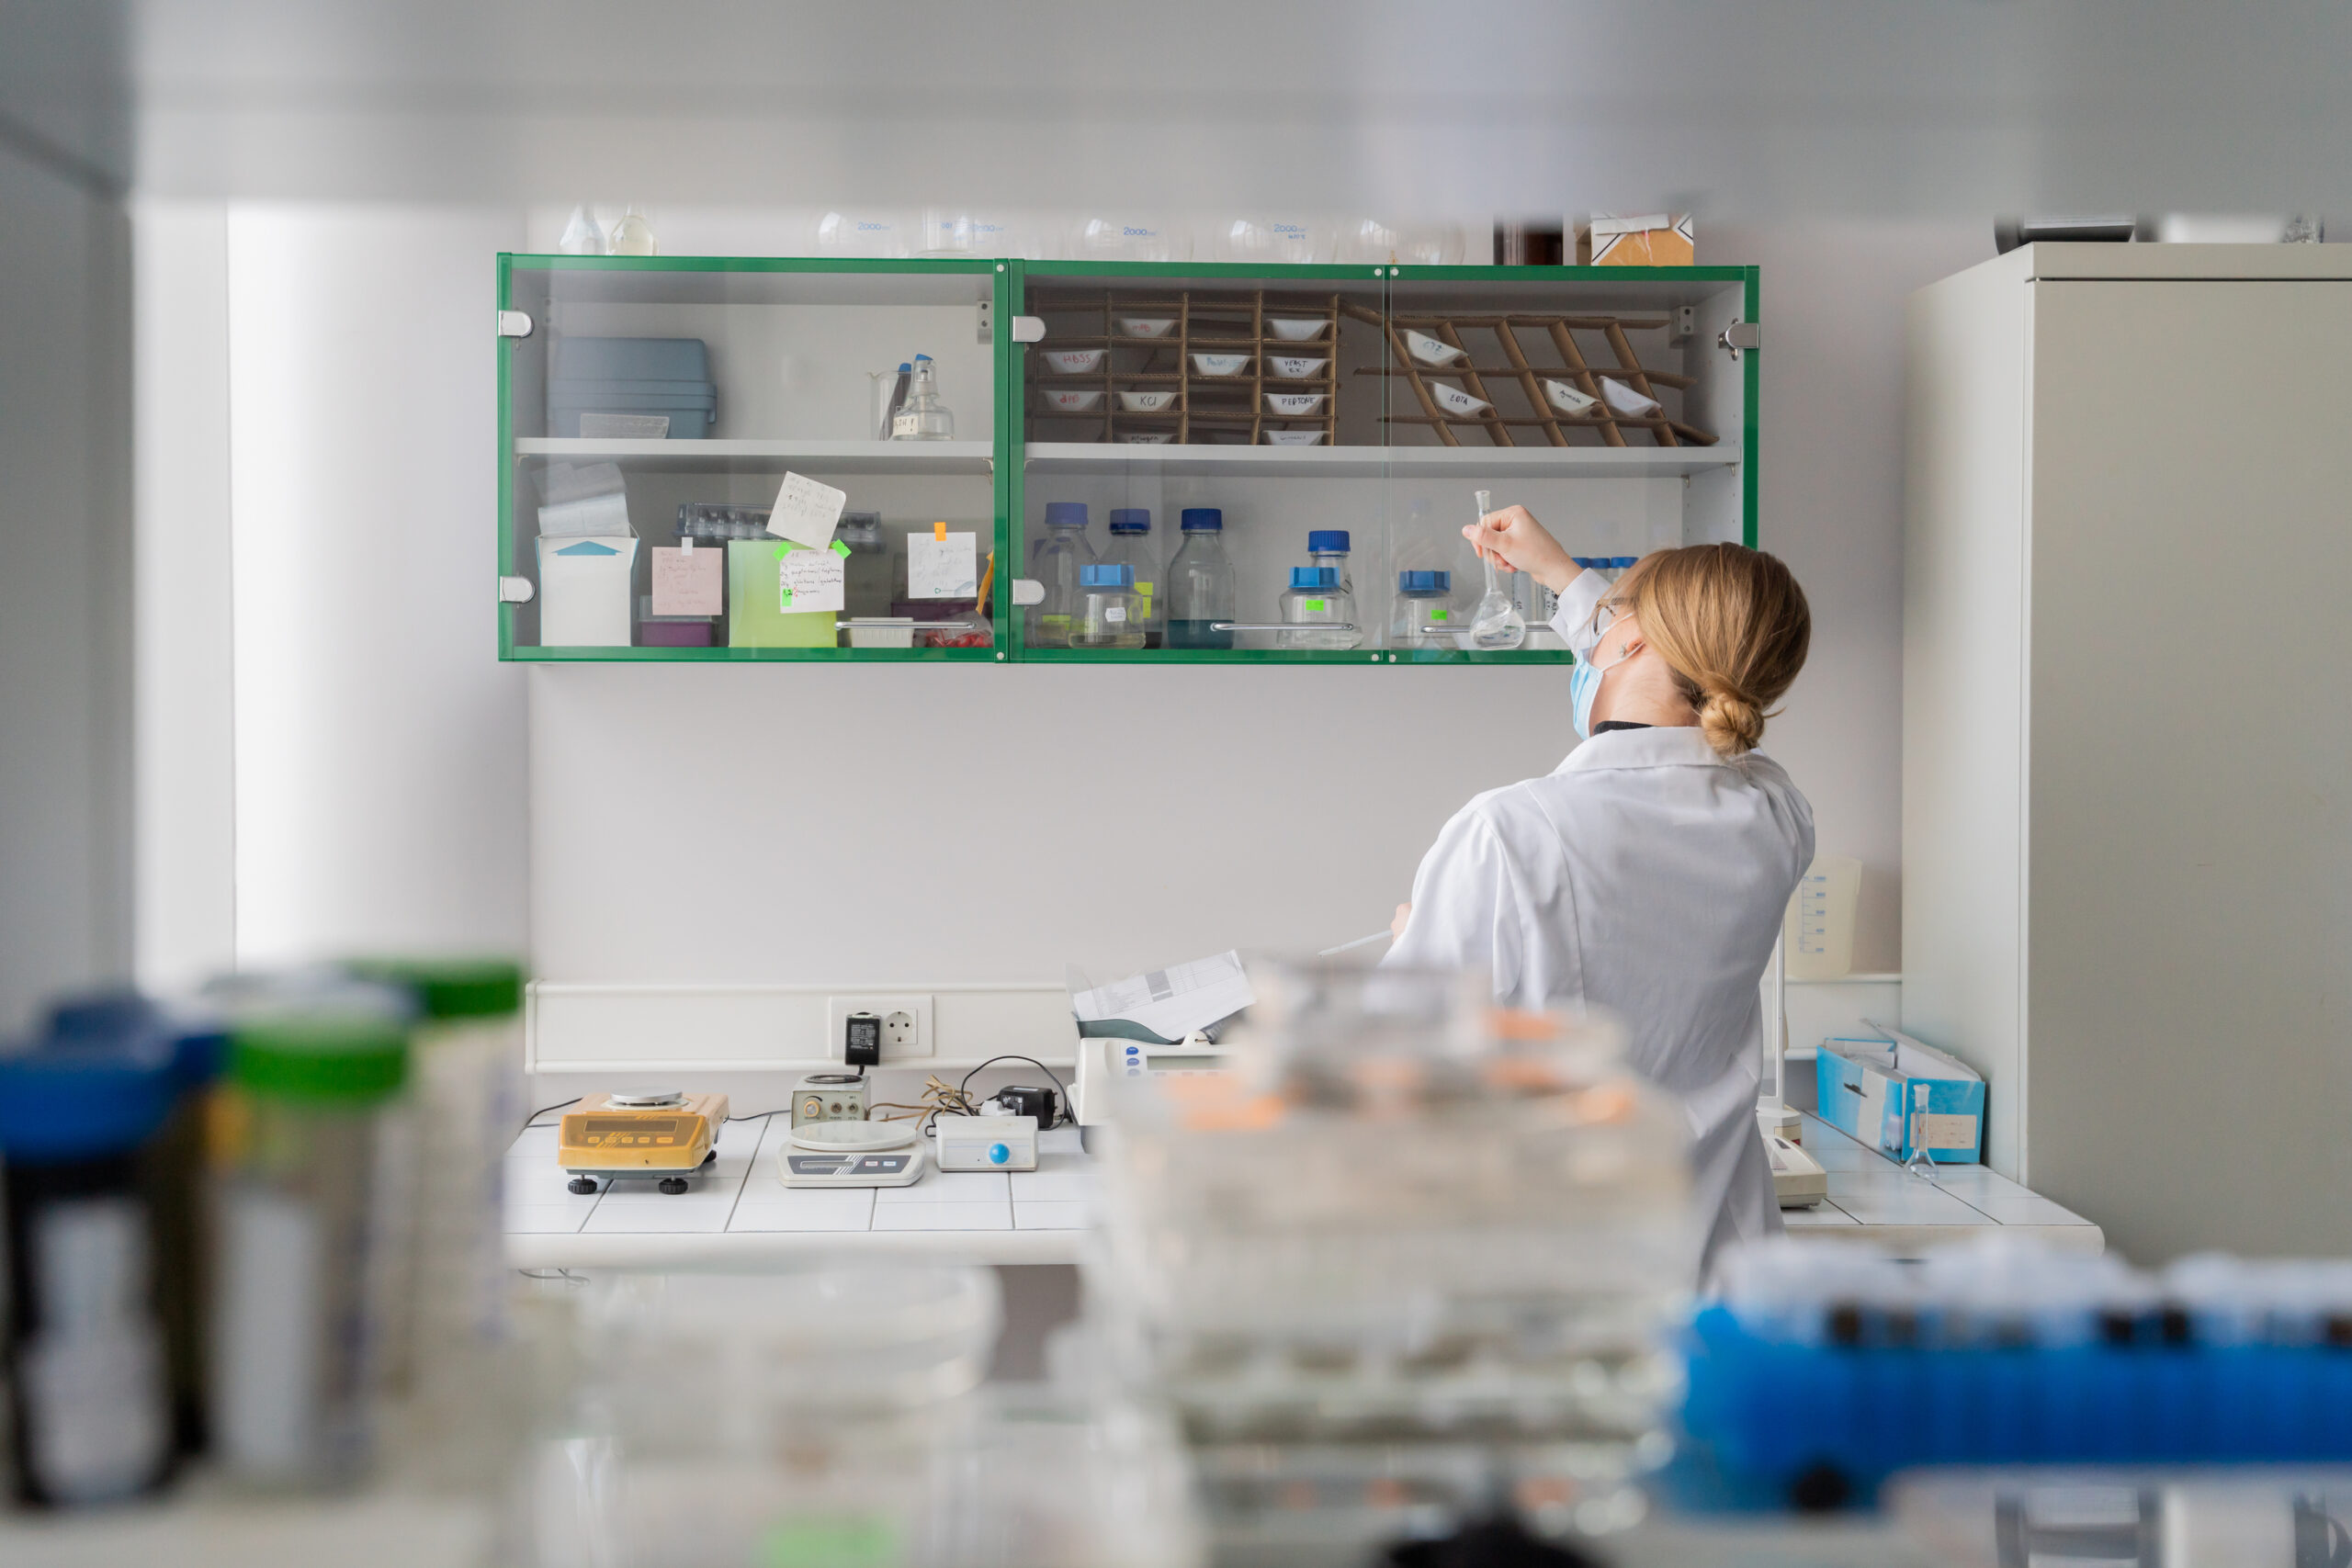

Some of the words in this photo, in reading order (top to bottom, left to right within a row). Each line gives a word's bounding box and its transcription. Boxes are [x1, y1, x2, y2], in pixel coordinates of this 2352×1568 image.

[857, 221, 882, 231] 2000
[1124, 226, 1148, 236] 2000
[1273, 223, 1298, 232] 2000
